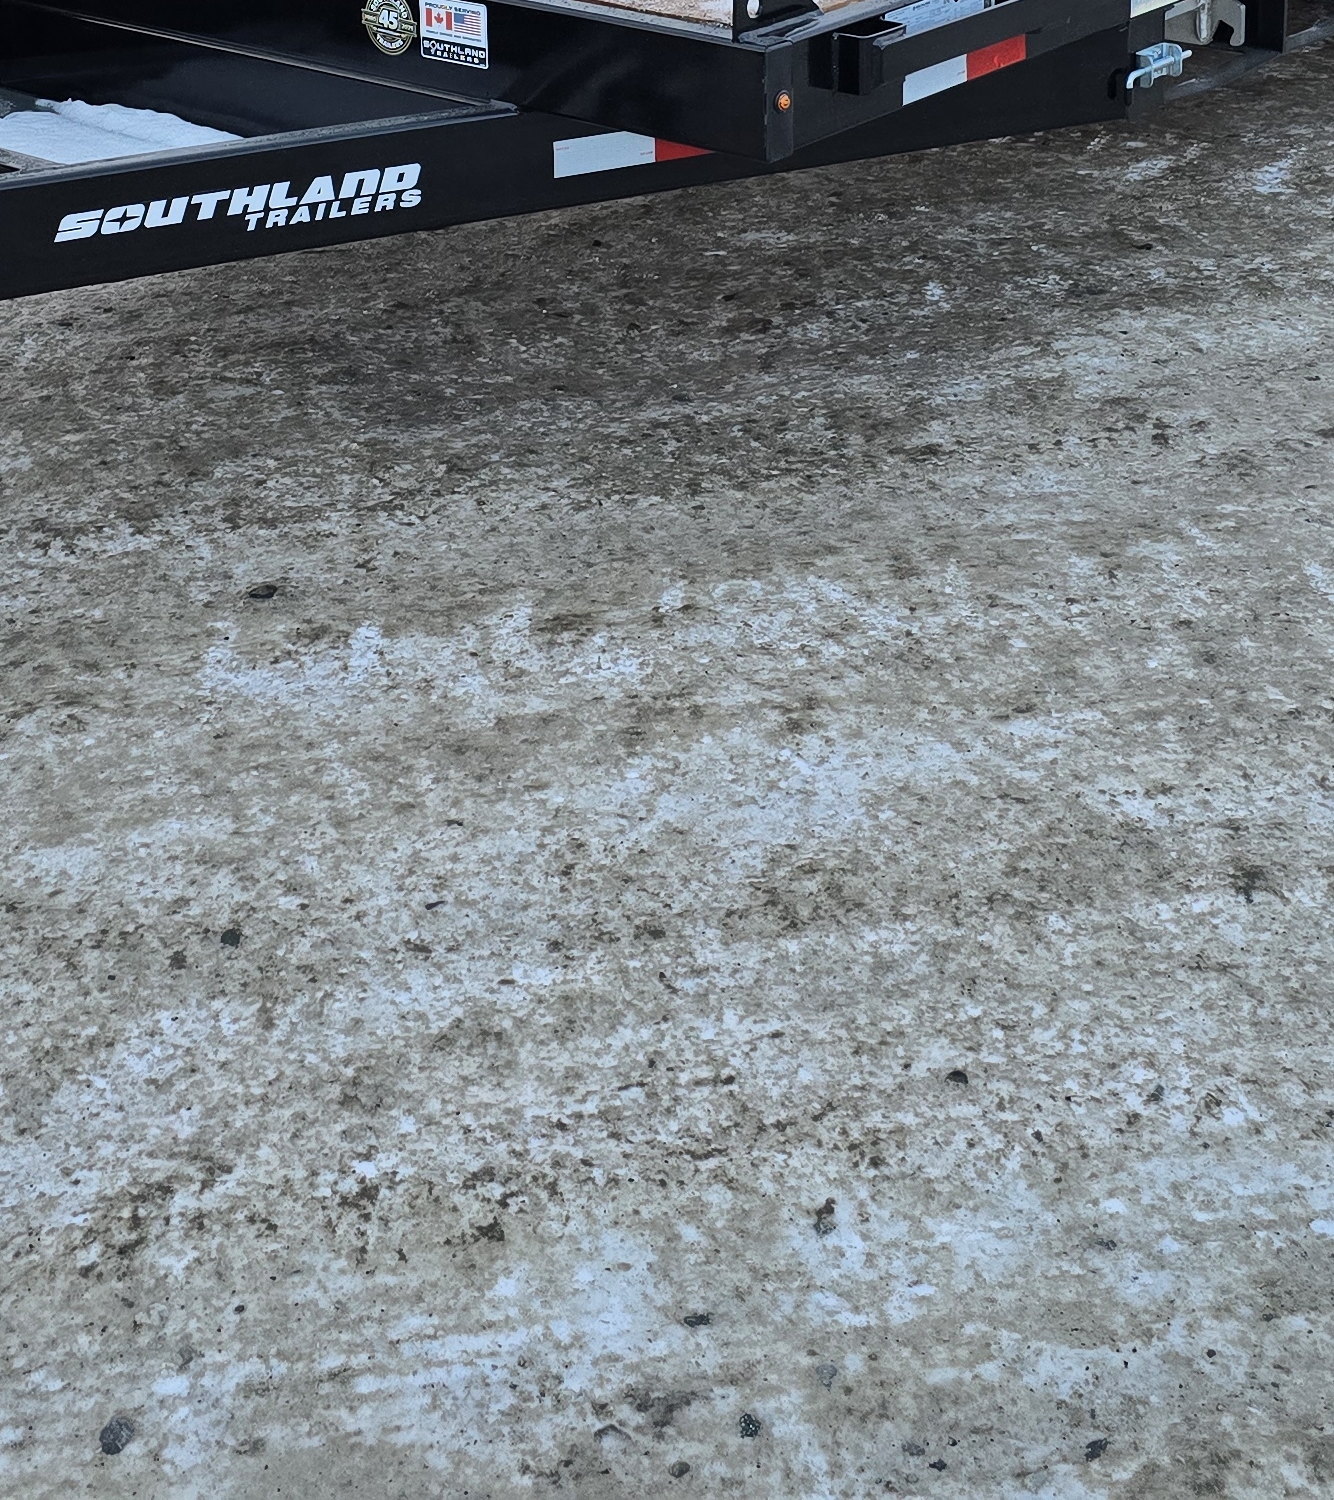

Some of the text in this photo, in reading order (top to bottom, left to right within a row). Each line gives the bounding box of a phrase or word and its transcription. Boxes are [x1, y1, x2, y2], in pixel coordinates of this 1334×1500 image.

[425, 2, 453, 10] PROUDLY
[378, 9, 398, 30] 45
[423, 40, 486, 58] SOUTHLAND
[53, 162, 422, 243] SOUTHLAND
[245, 188, 422, 232] TRAILERS
